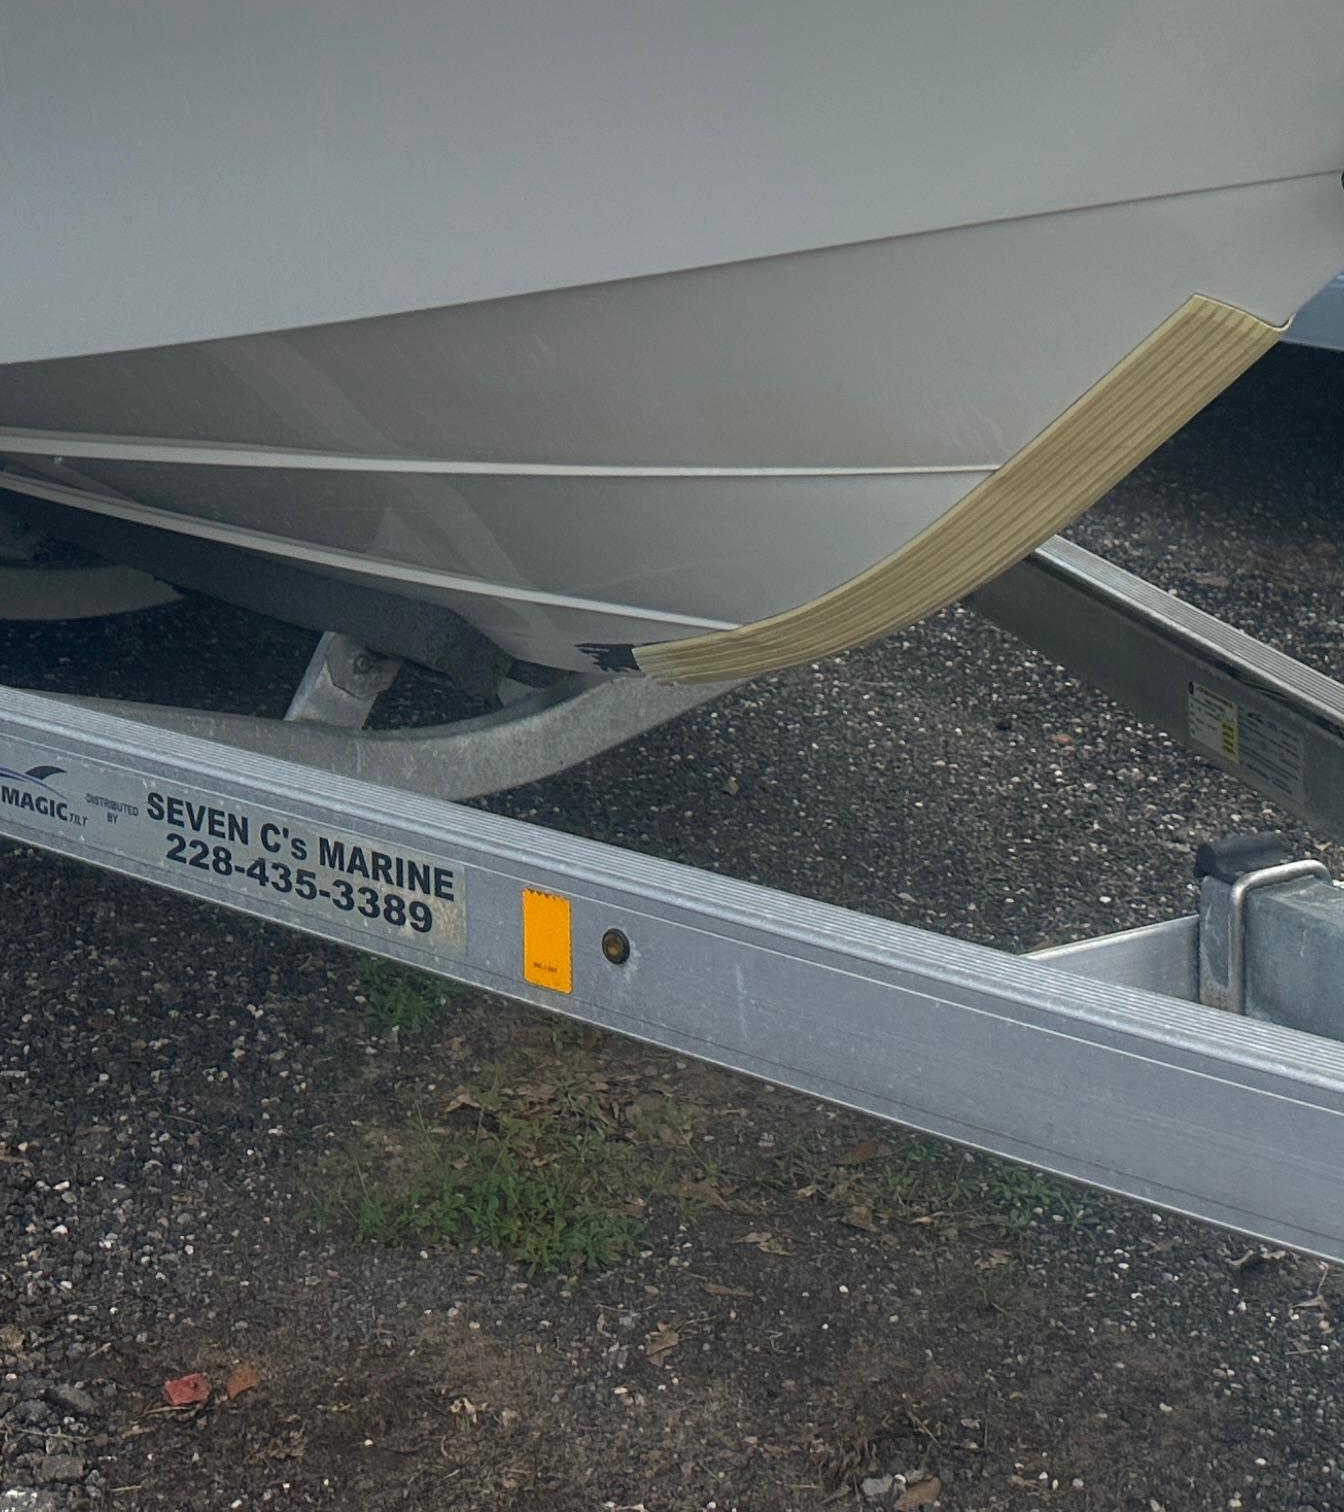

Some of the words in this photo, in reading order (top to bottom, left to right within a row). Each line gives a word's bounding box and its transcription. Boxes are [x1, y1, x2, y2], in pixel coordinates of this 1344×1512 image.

[86, 793, 139, 817] DISTRIBUTED
[107, 812, 119, 824] BY
[147, 792, 249, 845] SEVEN
[260, 823, 307, 861] C's
[319, 837, 455, 901] MARINE
[166, 833, 433, 933] 228-435-3389
